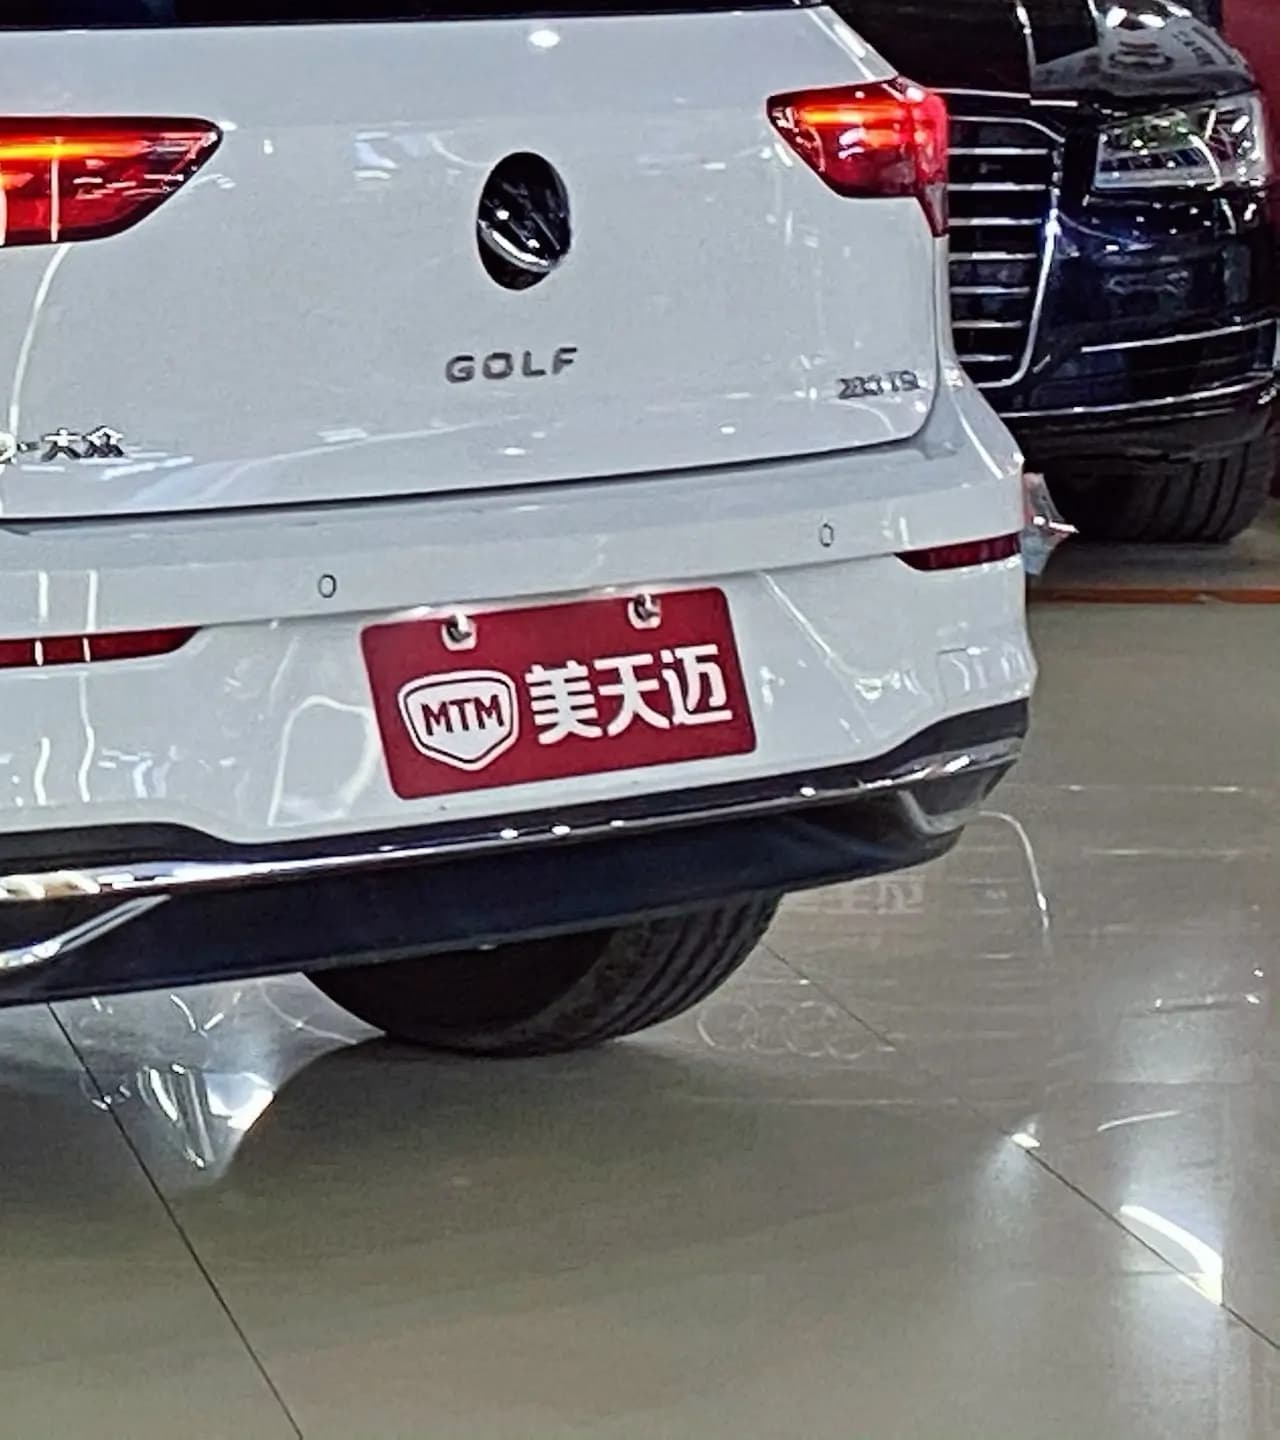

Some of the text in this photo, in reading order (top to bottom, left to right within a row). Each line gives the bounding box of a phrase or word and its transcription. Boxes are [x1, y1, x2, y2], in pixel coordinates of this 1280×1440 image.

[445, 346, 578, 384] GOLF
[420, 643, 733, 745] MTM 美天迈
